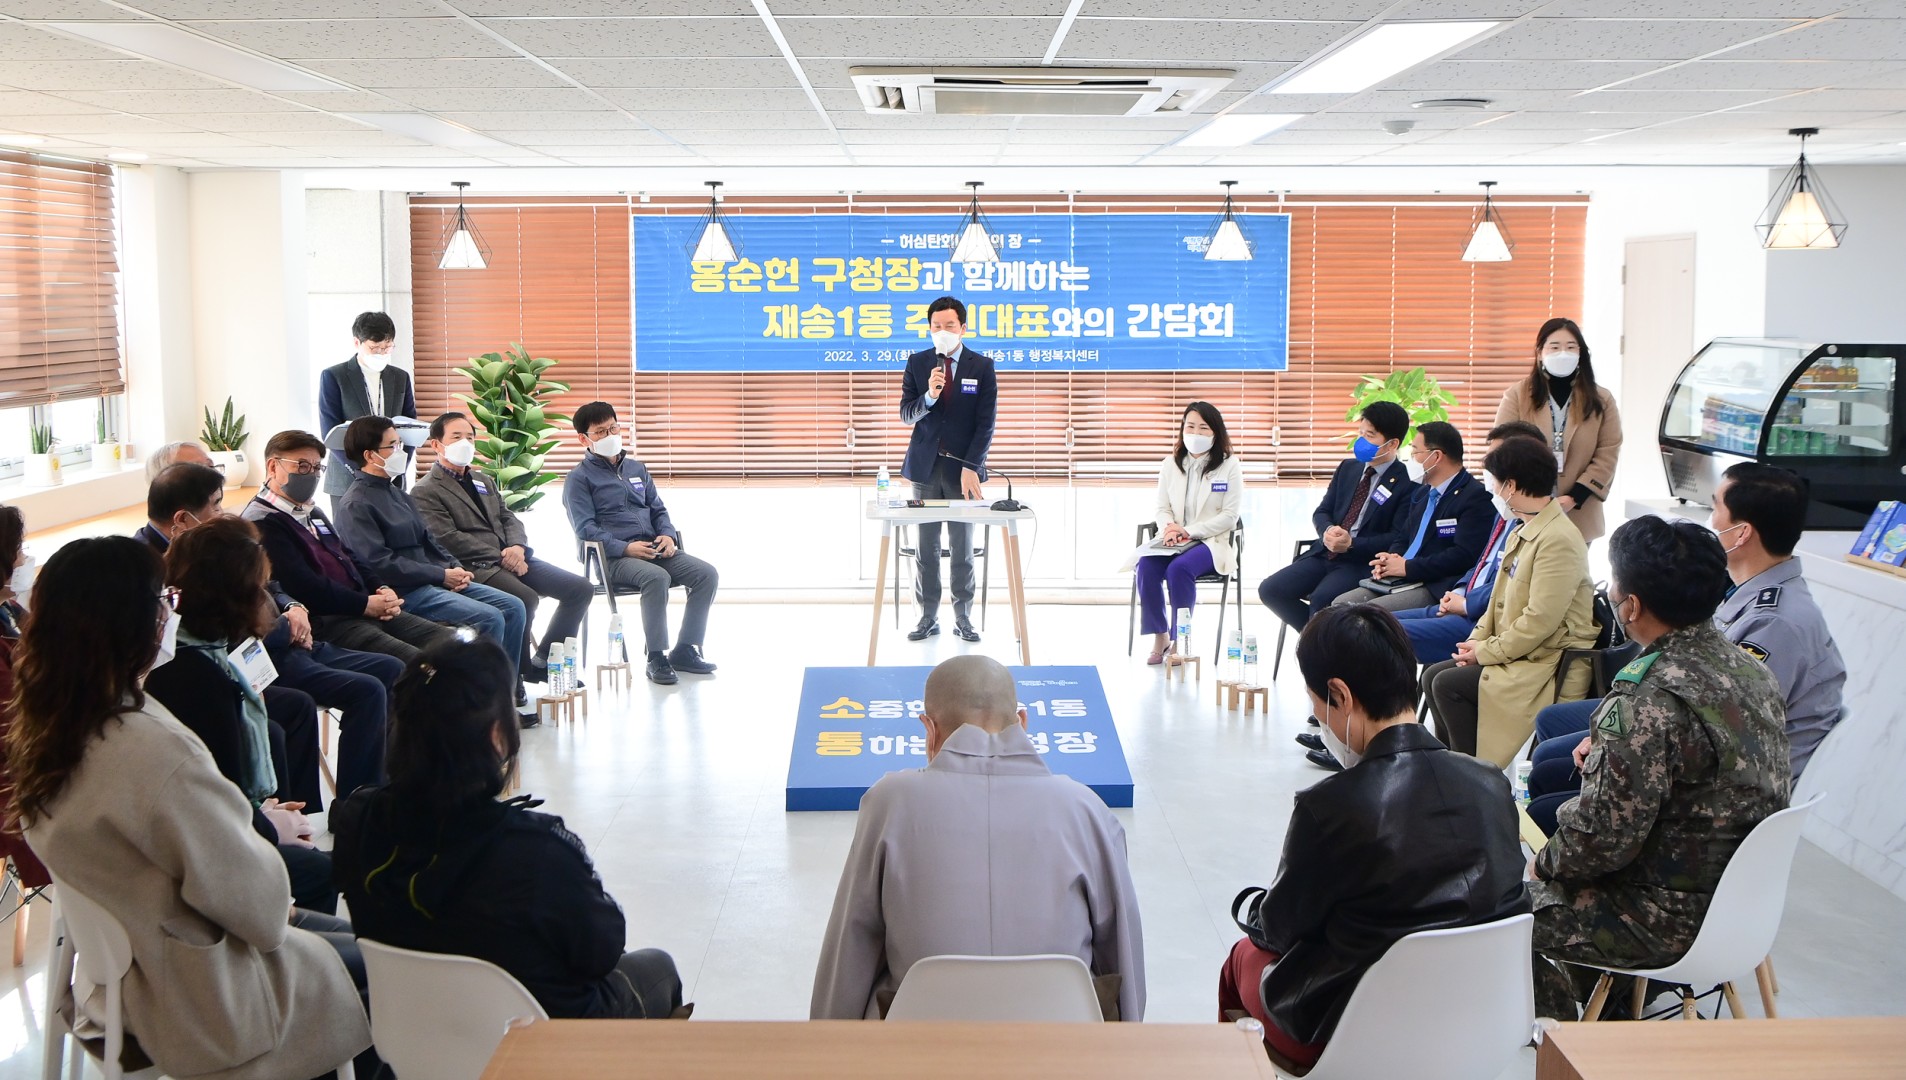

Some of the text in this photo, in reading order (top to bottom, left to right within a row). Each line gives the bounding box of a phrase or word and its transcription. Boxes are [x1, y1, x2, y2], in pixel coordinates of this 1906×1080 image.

[1007, 233, 1022, 249] 장
[690, 256, 1091, 293] 홍순헌 구청장과 함께하는
[762, 303, 894, 339] 재송1동
[1127, 302, 1234, 338] 간담회
[824, 350, 857, 362] 2022.
[861, 350, 873, 362] 3.
[1028, 349, 1099, 362] 행정복지센터
